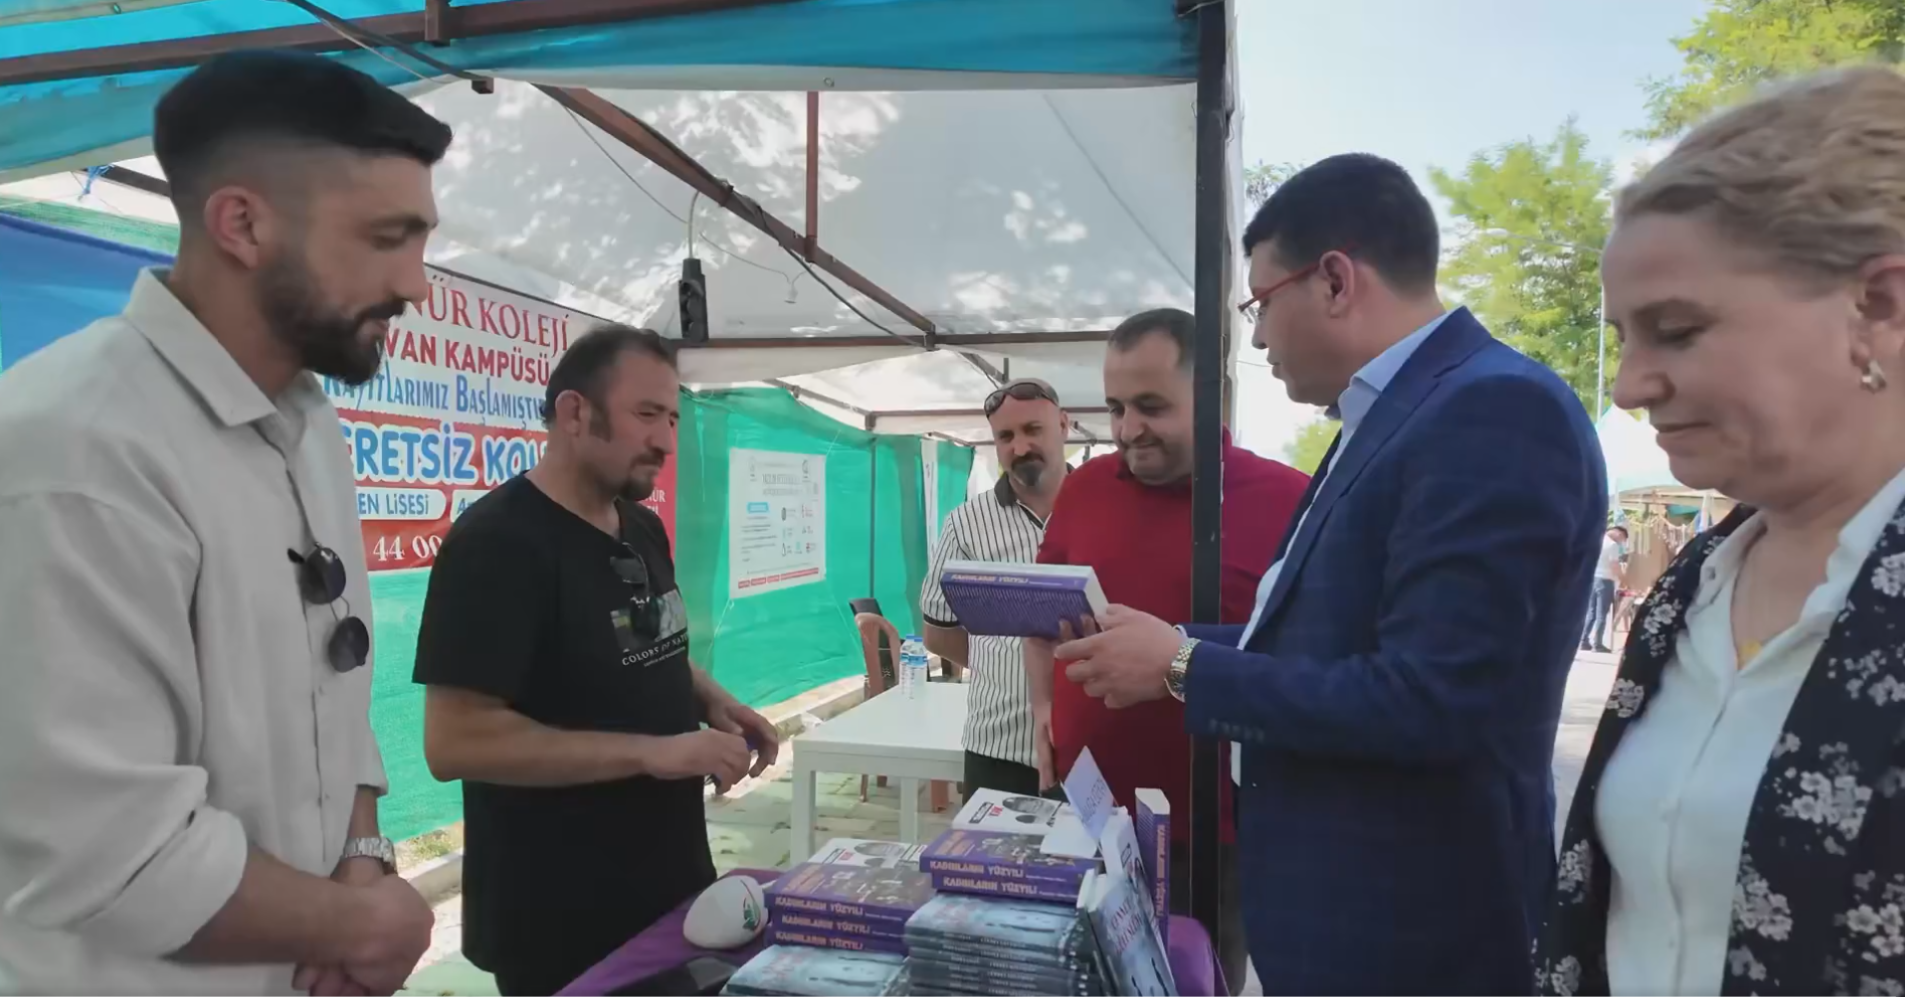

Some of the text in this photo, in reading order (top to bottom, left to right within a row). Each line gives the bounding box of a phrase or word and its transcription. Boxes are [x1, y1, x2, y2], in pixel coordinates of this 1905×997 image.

[478, 297, 569, 358] KOLEJİ
[445, 338, 550, 387] KAMPÜSÜ
[342, 423, 476, 480] RETSİZ
[386, 493, 429, 515] LİSESİ
[621, 646, 660, 667] COLORS
[929, 860, 984, 875] KADINLARIN
[988, 866, 1024, 879] YÜZYILI
[943, 876, 998, 891] KADINLARIN
[1001, 882, 1038, 895] YÜZYILI
[775, 896, 864, 916] KADINLARIN YÜZYILI
[781, 914, 834, 929] KADINLARIN
[837, 921, 871, 935] YÜZYILI
[775, 931, 864, 951] KADINLARIN YÜZYILI
